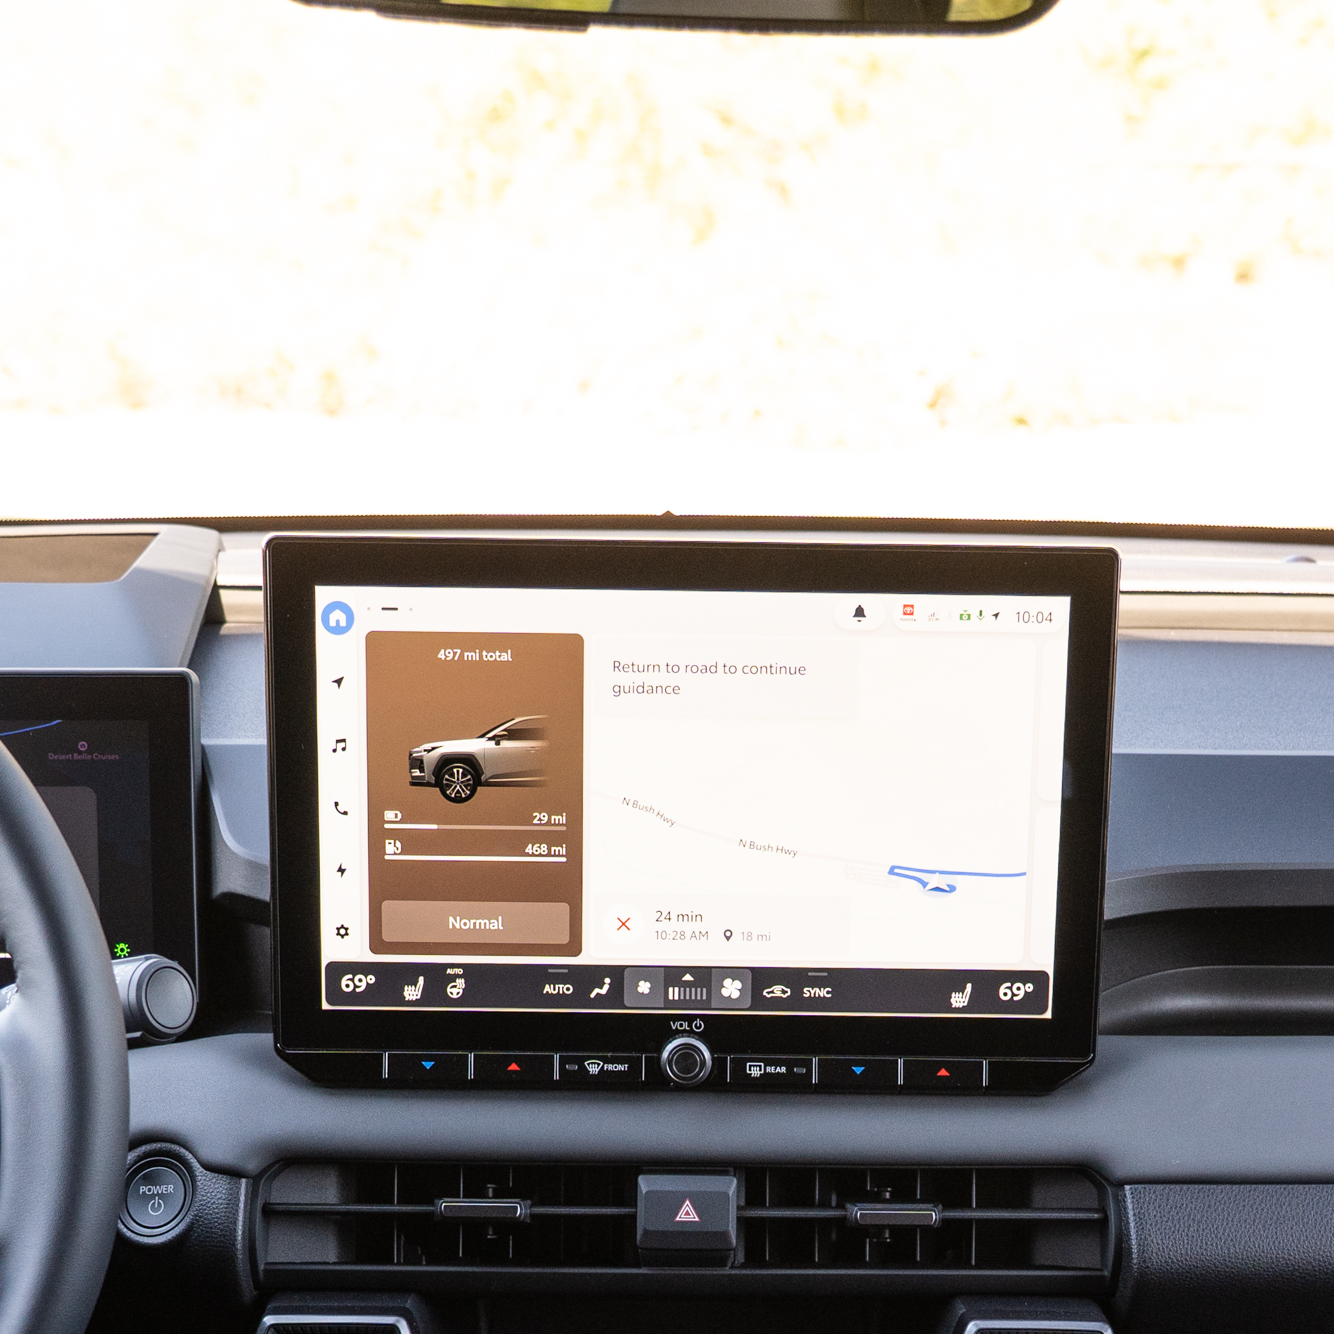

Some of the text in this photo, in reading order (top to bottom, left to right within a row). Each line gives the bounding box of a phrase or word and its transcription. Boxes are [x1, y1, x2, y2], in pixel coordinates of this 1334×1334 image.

[1015, 611, 1054, 625] 10:04
[438, 649, 512, 661] 497 mi total
[612, 660, 806, 676] Return to road to continue
[612, 682, 681, 698] guidance
[533, 812, 566, 824] 29 mi
[622, 797, 676, 828] N Bush Hwy
[525, 844, 566, 855] 468 mi
[738, 838, 798, 858] N Bush Hwy
[655, 910, 703, 923] 24 min
[448, 916, 504, 931] Normal
[654, 930, 710, 942] 10:28 AM
[740, 931, 771, 942] 18 mi
[341, 974, 376, 993] 69°
[543, 984, 574, 996] AUTO
[803, 986, 832, 998] SYNC
[998, 982, 1034, 1002] 69°
[670, 1021, 690, 1031] VOL
[604, 1063, 629, 1073] FRONT
[766, 1065, 787, 1075] REAR
[139, 1184, 175, 1196] POWER
